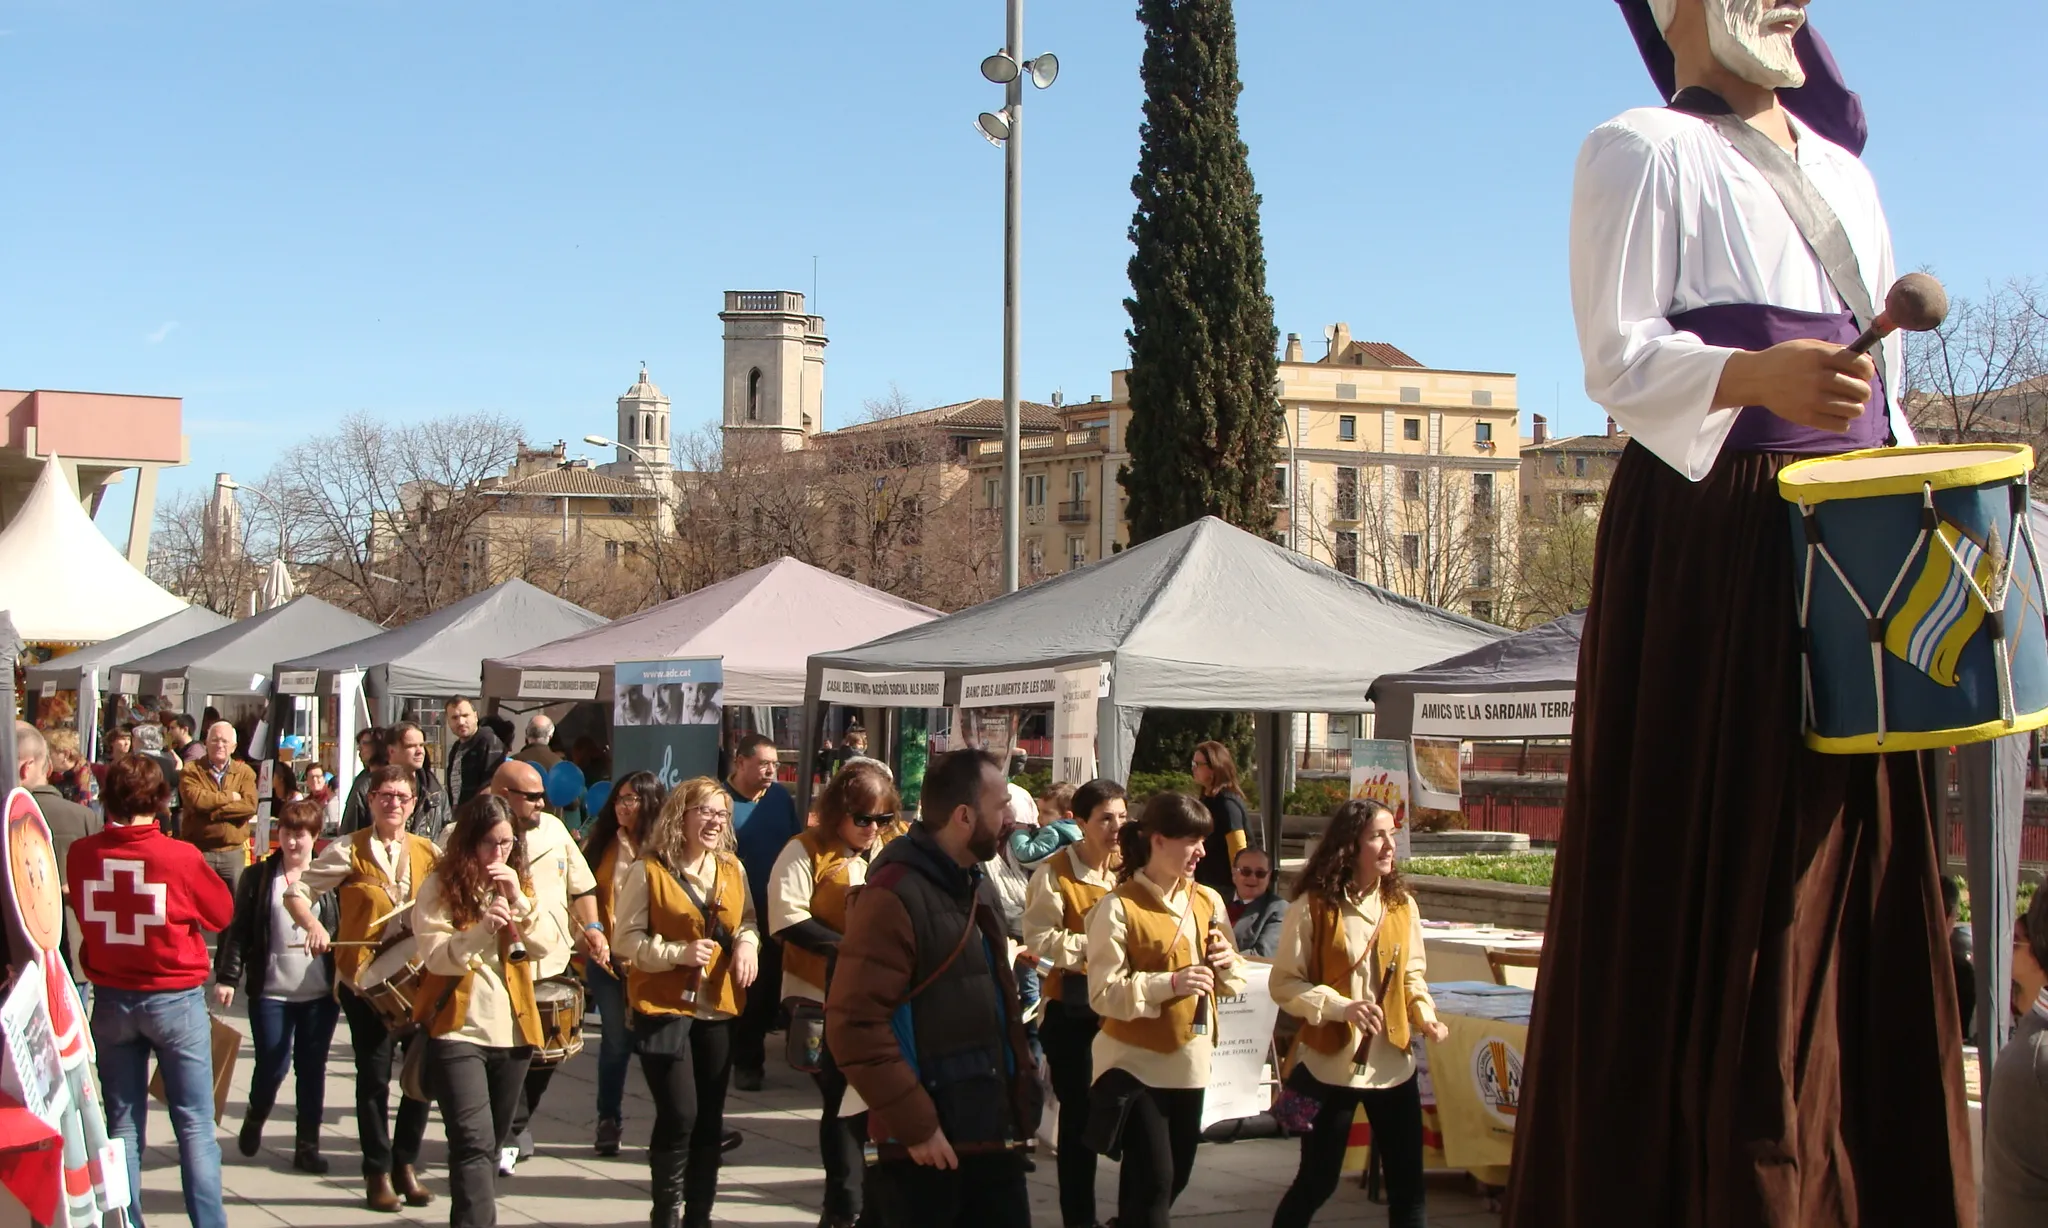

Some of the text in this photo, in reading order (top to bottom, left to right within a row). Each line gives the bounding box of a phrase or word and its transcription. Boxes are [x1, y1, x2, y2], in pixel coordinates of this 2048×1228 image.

[643, 668, 691, 679] www.adc.cat
[827, 680, 842, 692] CASAL
[842, 681, 853, 693] DELS
[889, 683, 909, 695] SOCIAL
[909, 683, 919, 695] ALS
[920, 683, 939, 695] BARRIS
[965, 685, 980, 698] BANC
[980, 684, 994, 697] DELS
[994, 682, 1021, 697] ALIMENTS
[1022, 682, 1030, 694] DE
[1030, 681, 1039, 693] LES
[1421, 703, 1452, 719] AMICS
[1453, 704, 1465, 720] DE
[1467, 704, 1481, 720] LA
[1485, 703, 1537, 720] SARDANA
